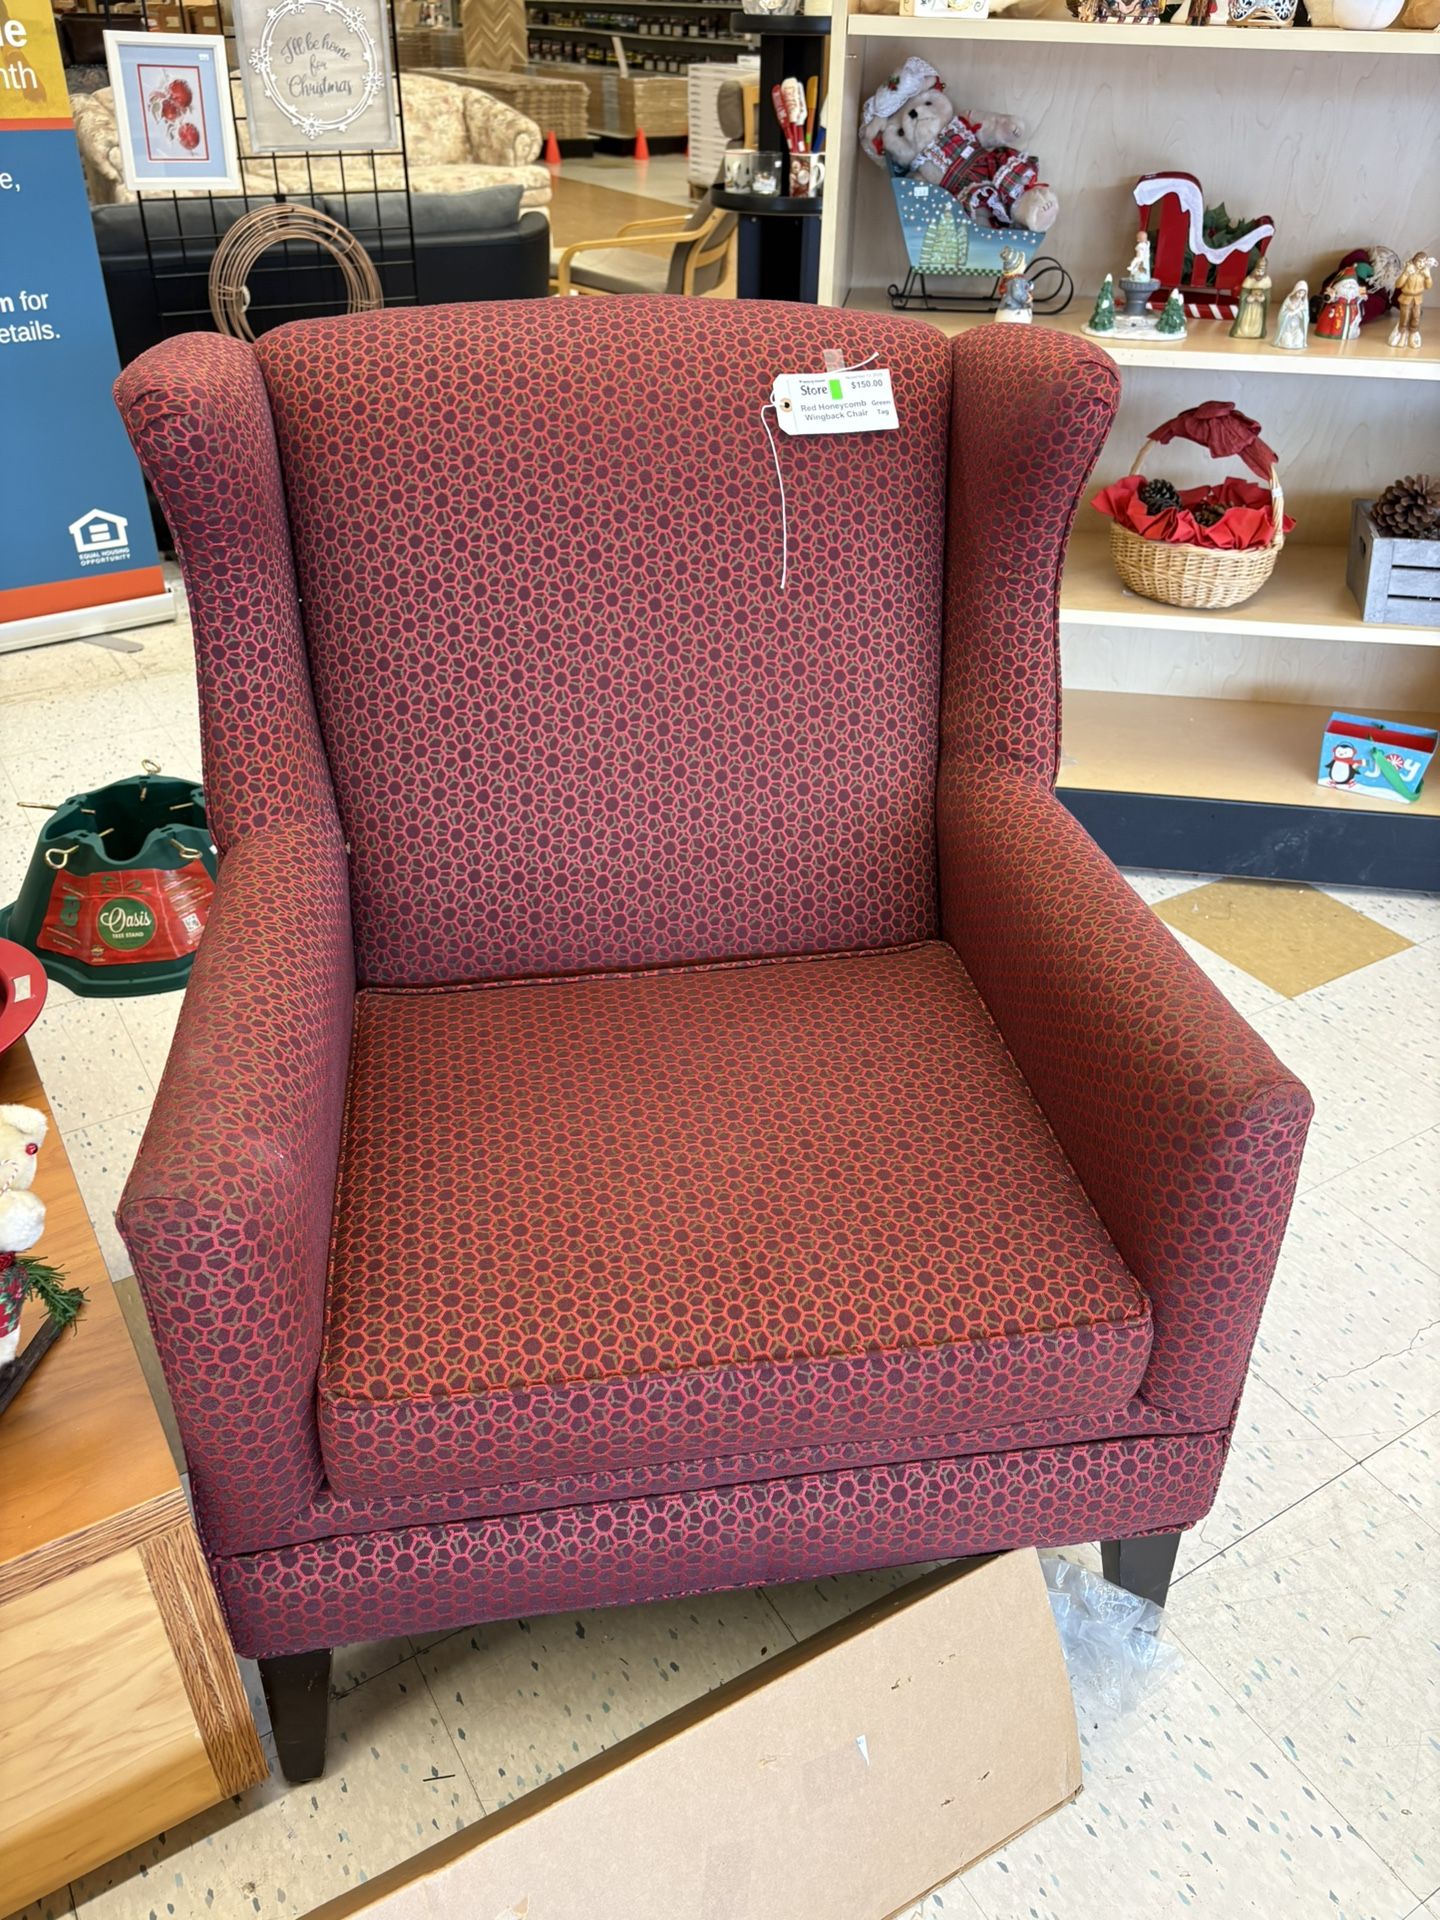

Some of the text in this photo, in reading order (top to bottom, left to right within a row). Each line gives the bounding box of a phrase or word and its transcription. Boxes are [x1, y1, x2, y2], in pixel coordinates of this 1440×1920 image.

[305, 31, 320, 51] be
[321, 33, 351, 59] home
[309, 53, 328, 77] for
[287, 73, 352, 97] Christmas
[18, 290, 49, 312] for
[800, 379, 883, 396] Store $150.00
[800, 400, 867, 412] Red Honeycomb
[871, 399, 891, 407] Green
[876, 408, 890, 416] Tag
[805, 408, 868, 422] Wingback Chair
[100, 907, 152, 933] Oasis
